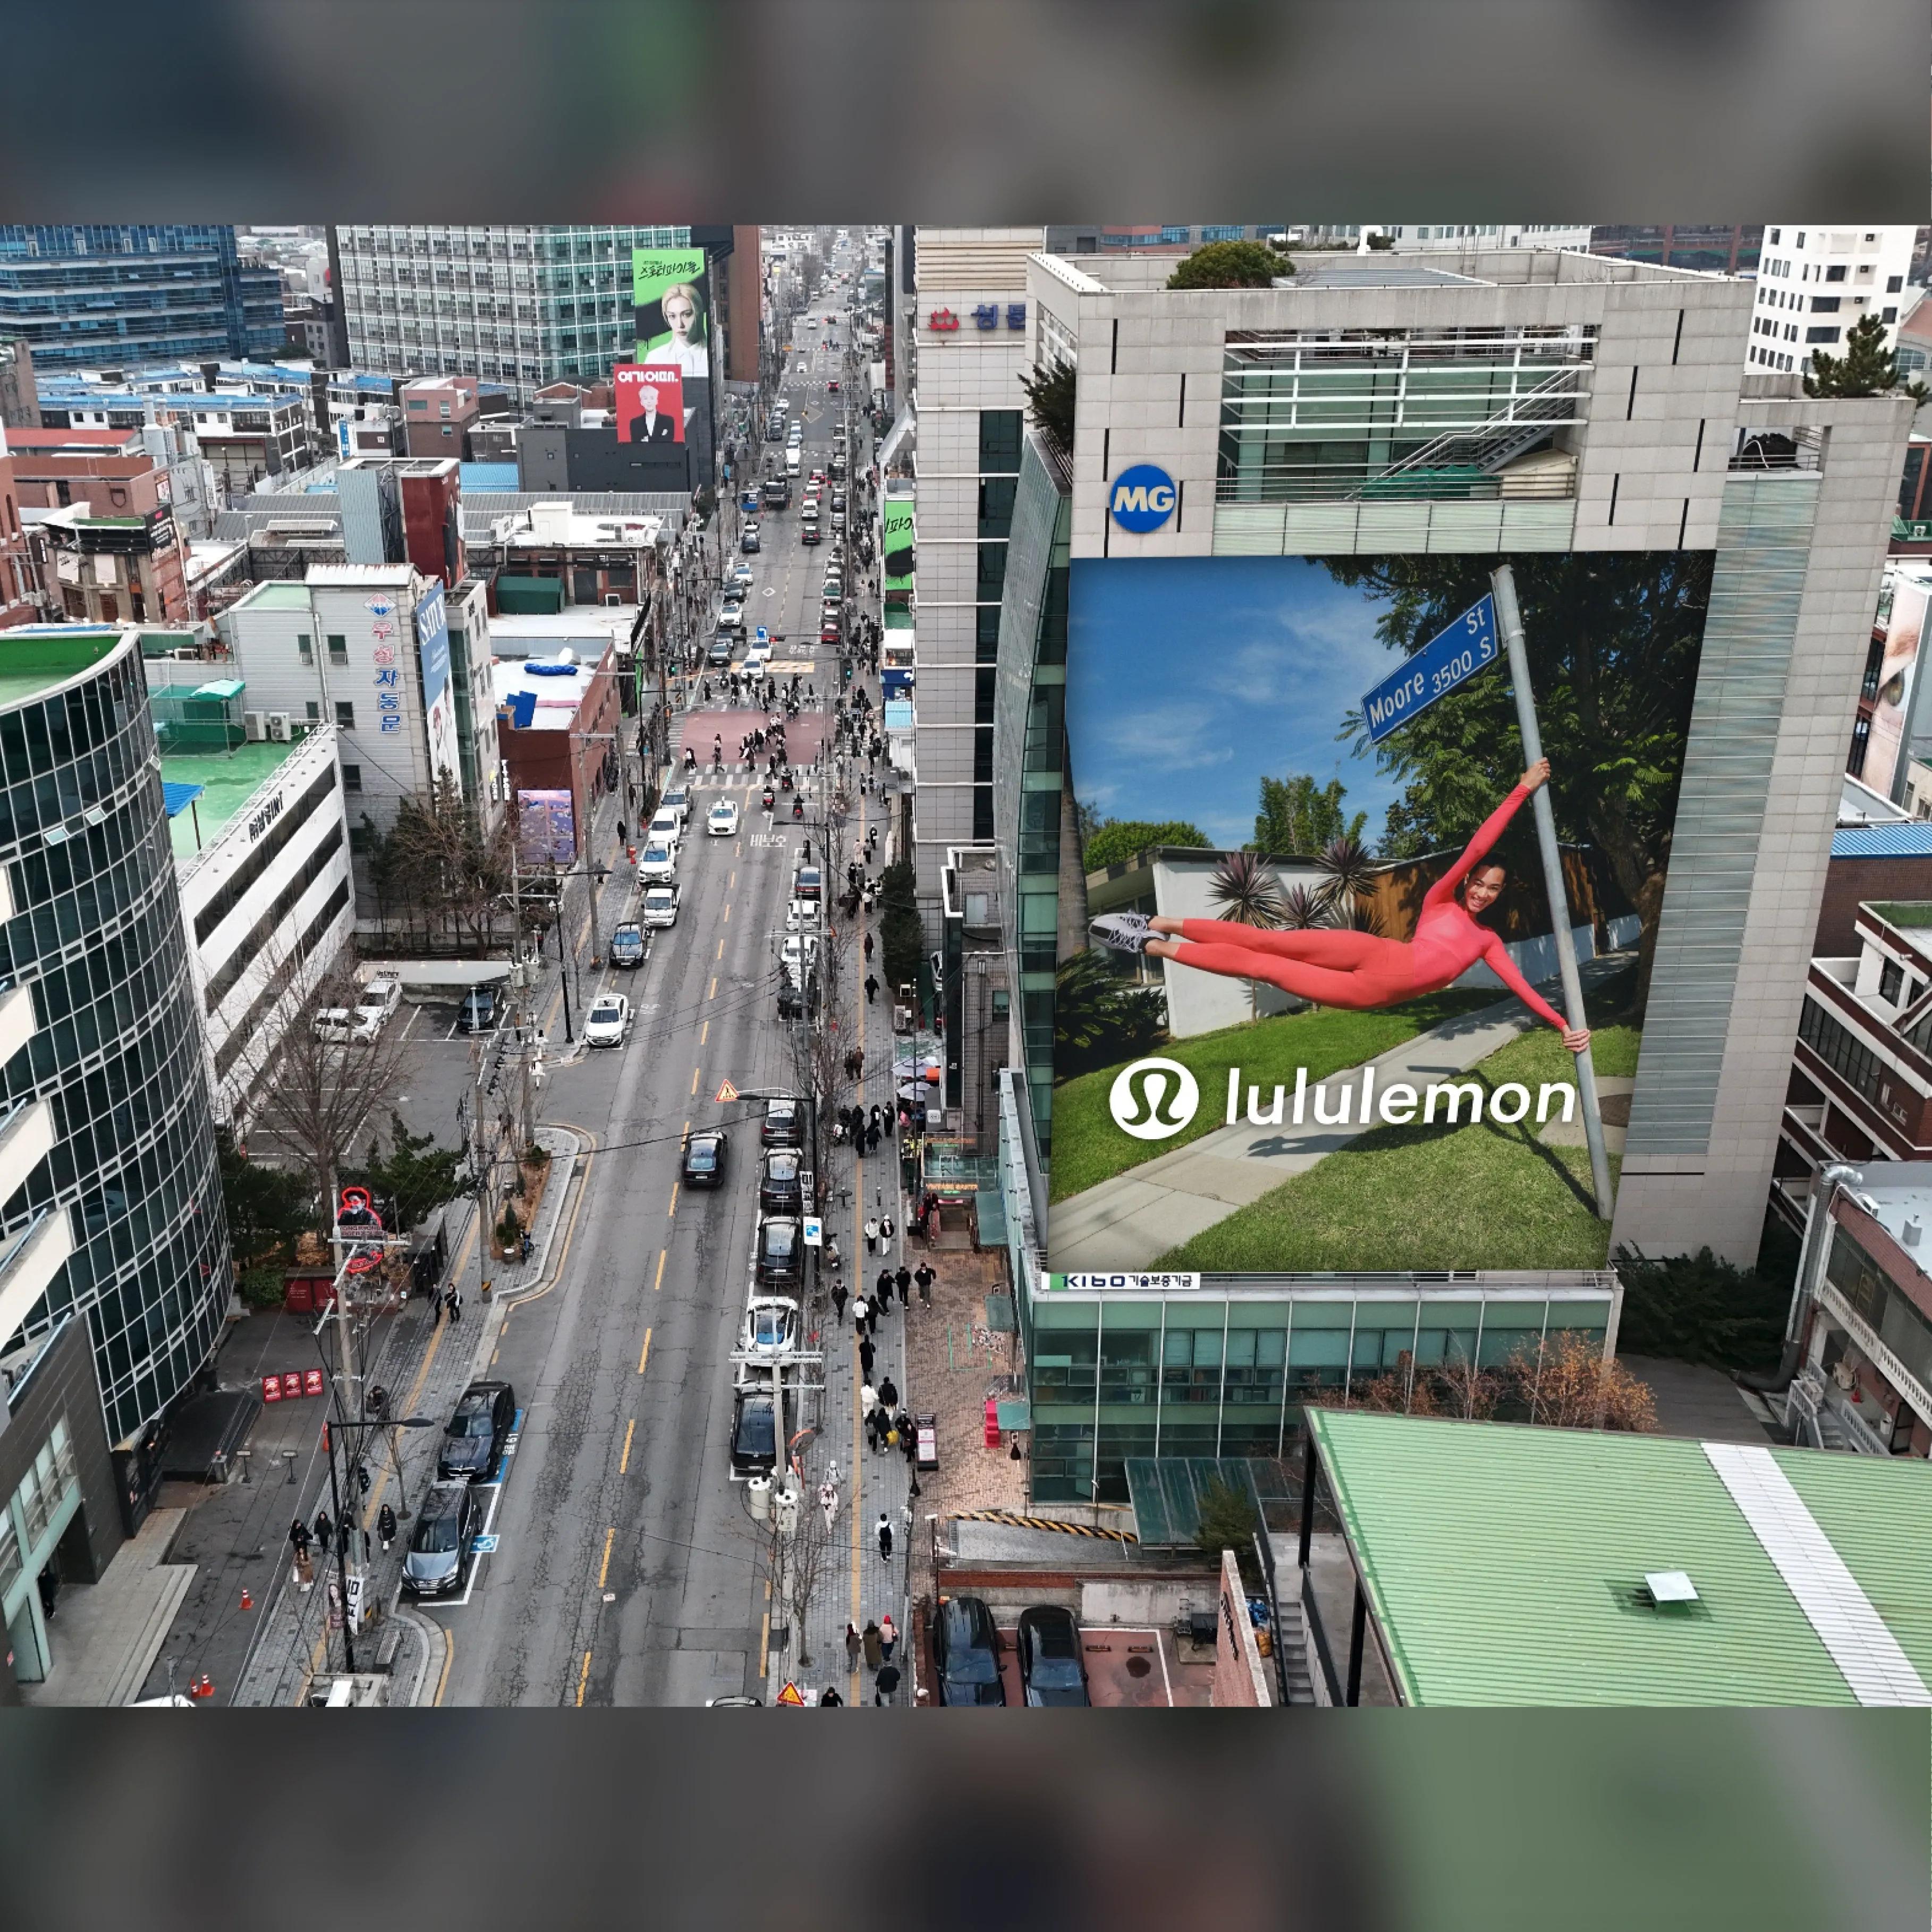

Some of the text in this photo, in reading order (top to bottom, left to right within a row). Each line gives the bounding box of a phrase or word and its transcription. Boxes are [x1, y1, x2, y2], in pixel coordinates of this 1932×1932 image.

[1113, 485, 1175, 512] MG
[371, 620, 402, 734] 우성자동문
[1369, 606, 1486, 728] Moore St
[1431, 636, 1492, 694] 3500 S
[750, 834, 787, 848] 비보호
[1226, 1067, 1576, 1125] lululemon
[1128, 1275, 1193, 1287] 기술보증기금
